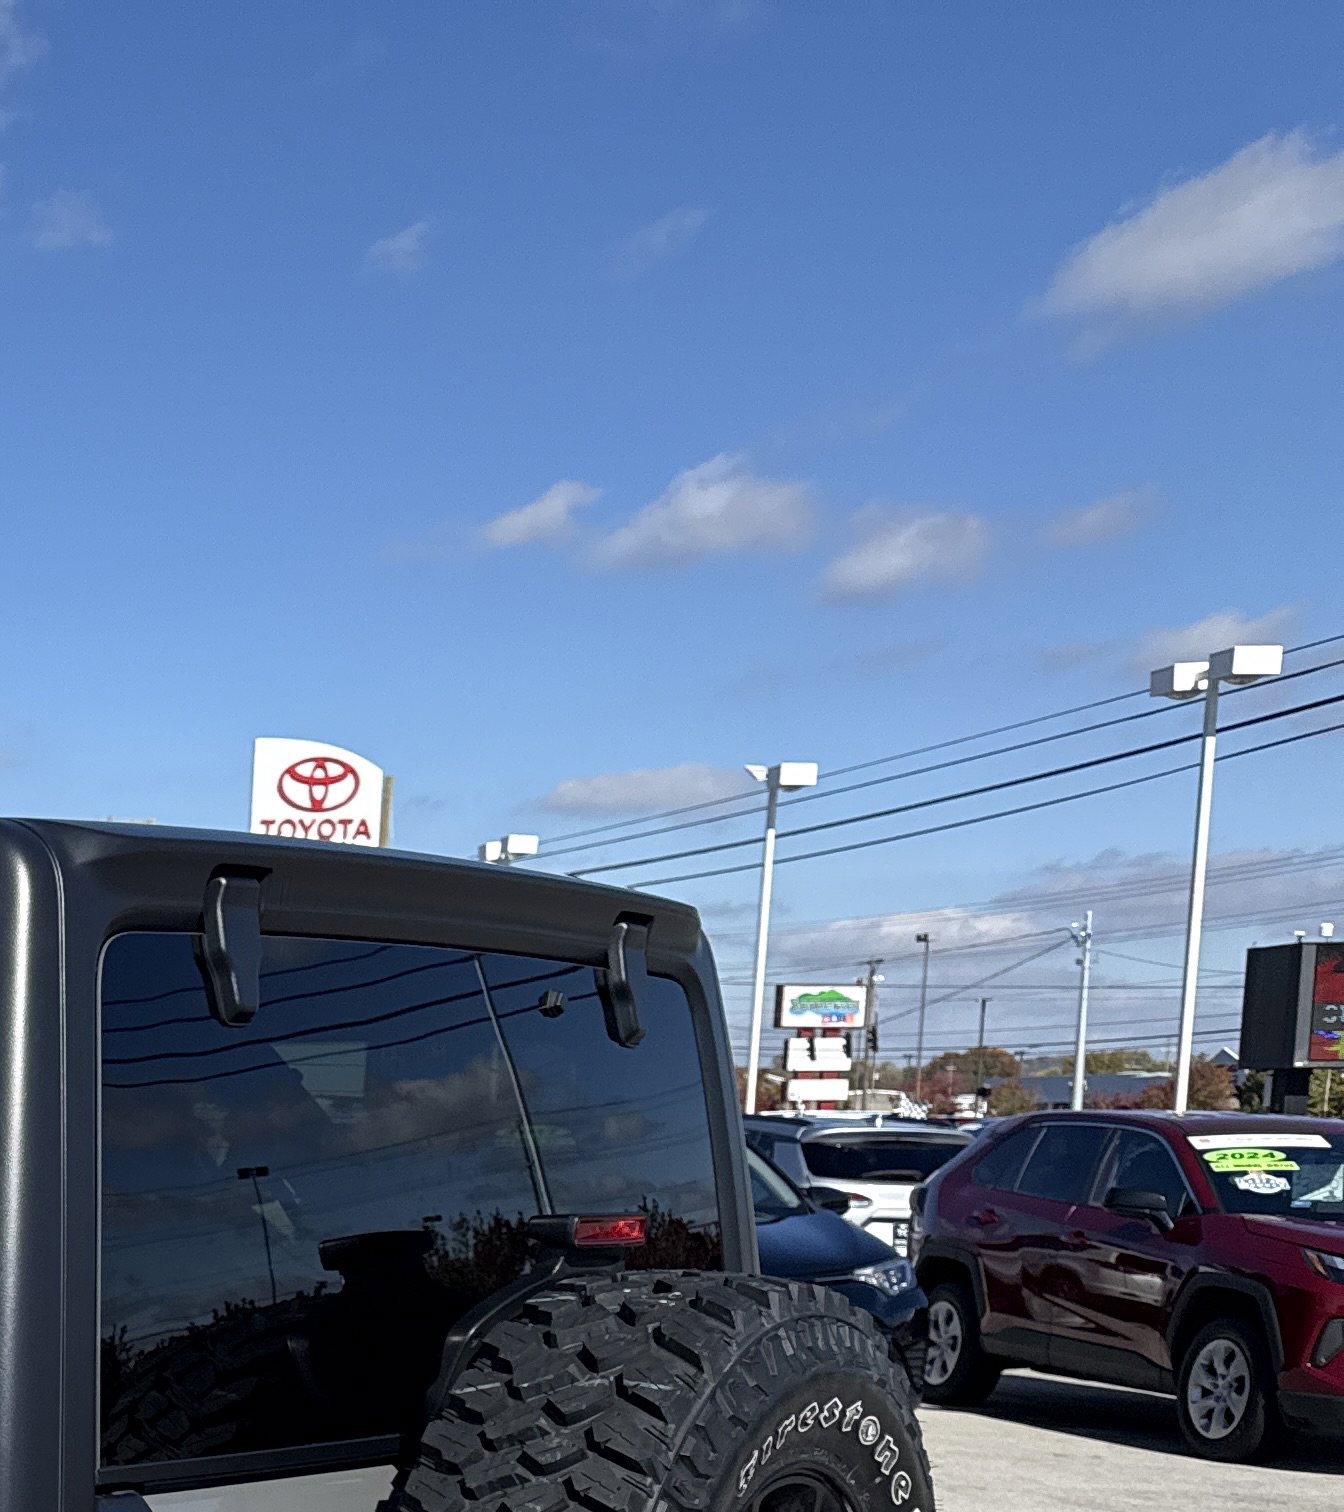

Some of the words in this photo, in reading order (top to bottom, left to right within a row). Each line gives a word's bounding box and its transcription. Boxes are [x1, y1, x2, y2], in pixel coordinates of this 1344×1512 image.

[260, 818, 371, 842] TOYOTA
[1215, 1151, 1277, 1161] 2024
[737, 1398, 913, 1505] Firestone
